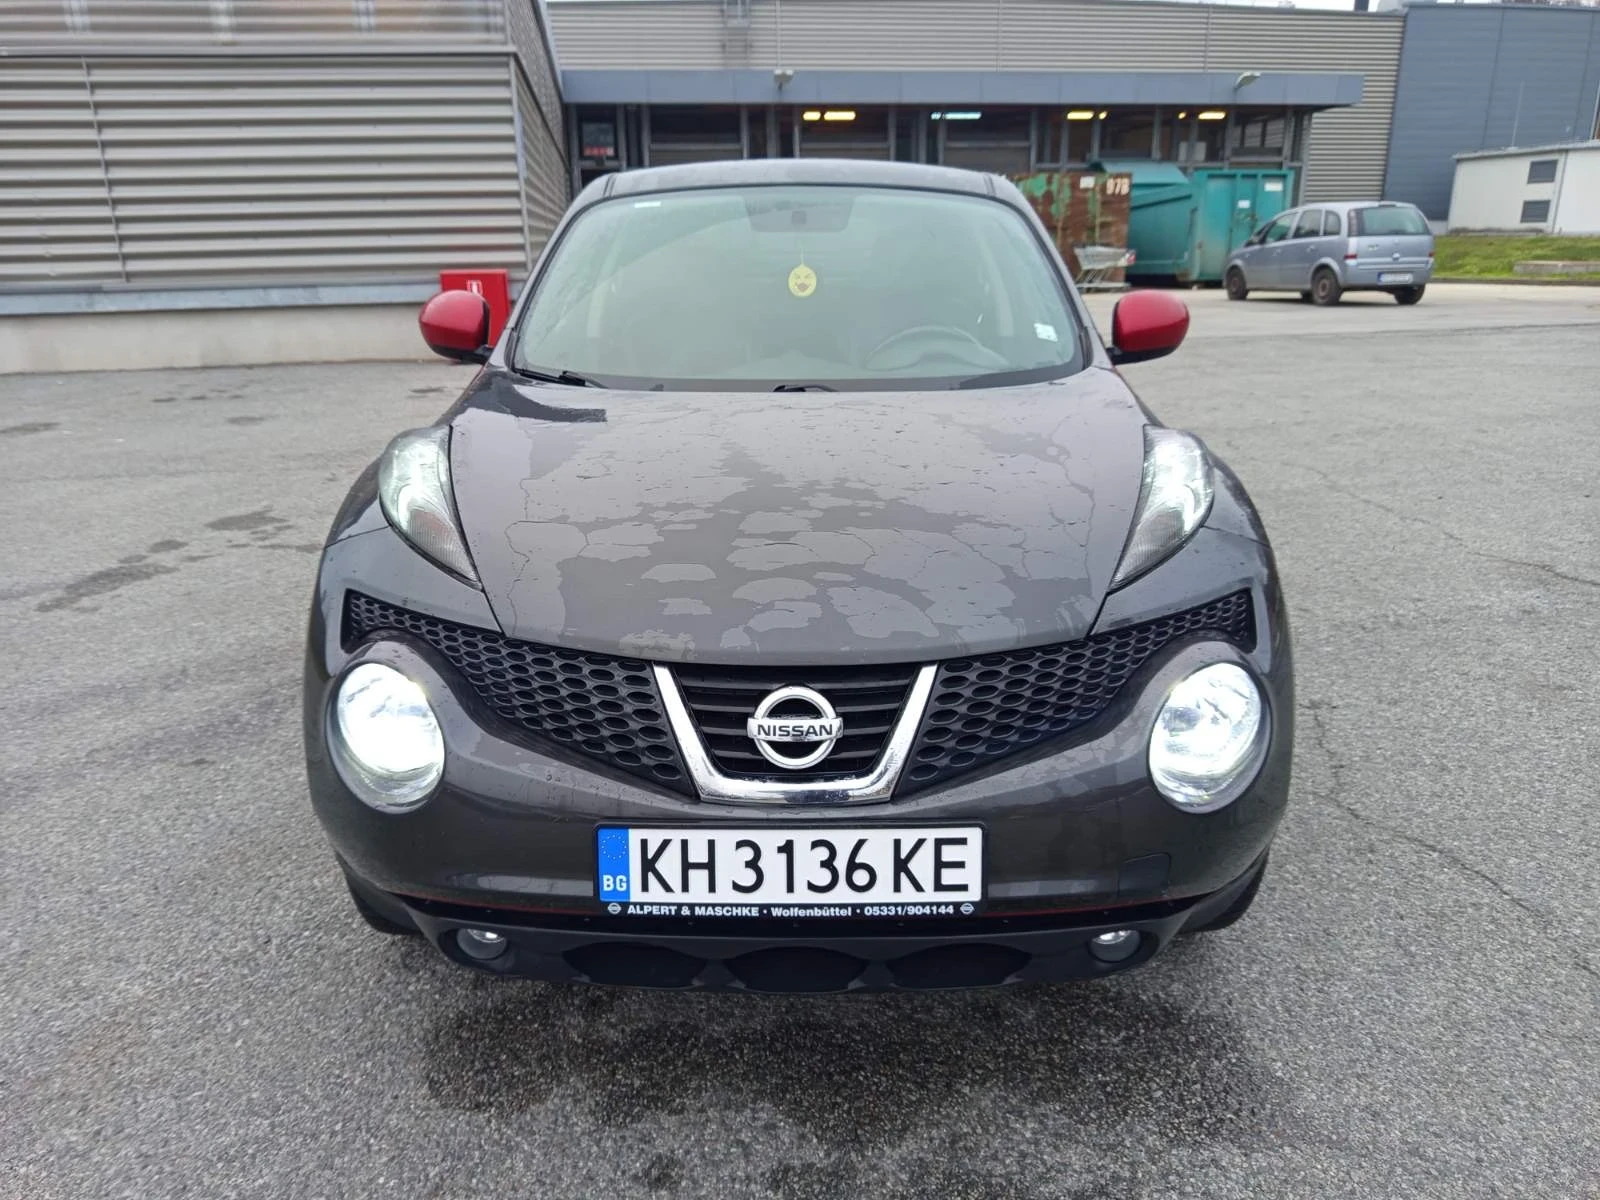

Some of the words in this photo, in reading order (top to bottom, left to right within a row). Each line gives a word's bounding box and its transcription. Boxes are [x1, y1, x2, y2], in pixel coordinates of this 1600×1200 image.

[757, 724, 833, 737] NISSAN
[639, 838, 717, 894] KH
[731, 838, 877, 894] 3136
[892, 837, 969, 893] KE
[603, 875, 627, 891] BG
[627, 905, 677, 915] ALPERT
[681, 906, 690, 916] &
[695, 906, 759, 916] MASCHKE
[770, 906, 851, 917] Wolfenbüttel
[864, 905, 954, 916] 05331/904144
